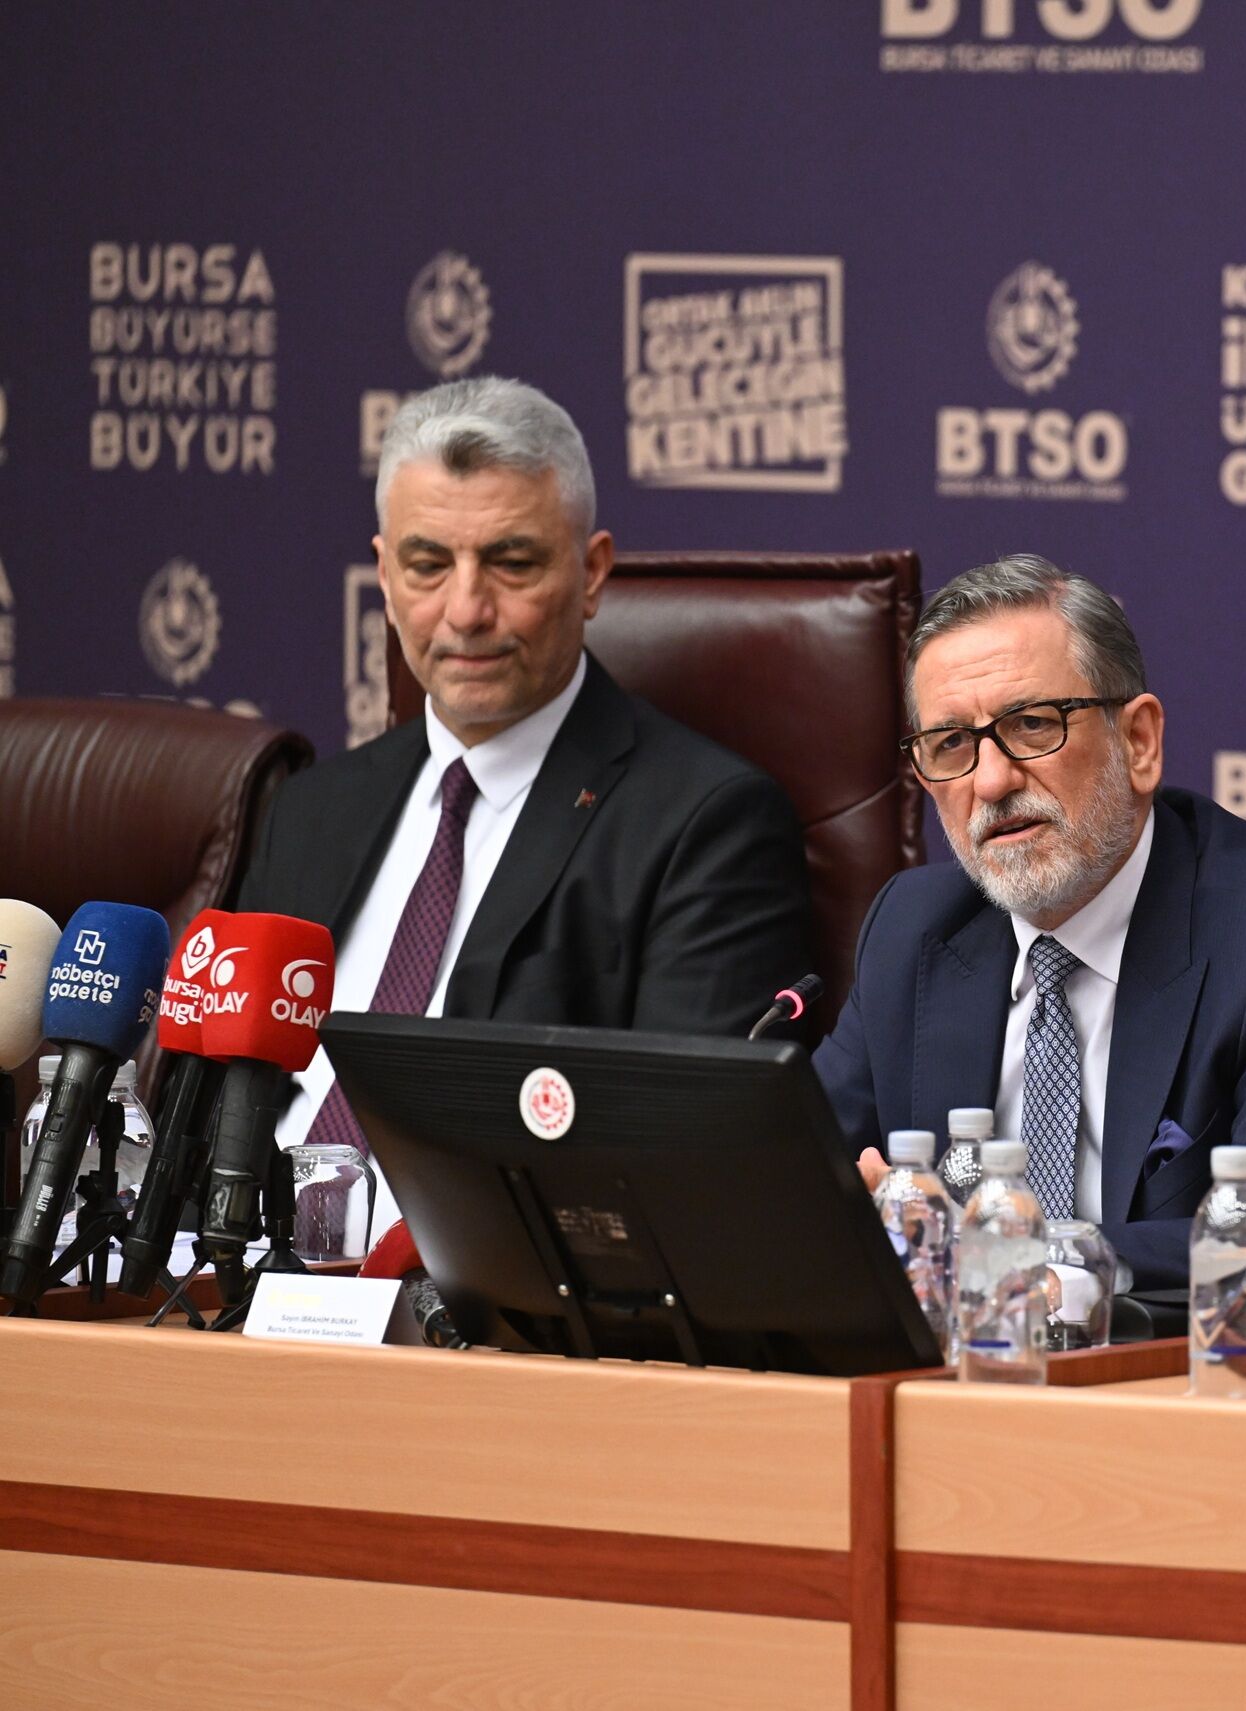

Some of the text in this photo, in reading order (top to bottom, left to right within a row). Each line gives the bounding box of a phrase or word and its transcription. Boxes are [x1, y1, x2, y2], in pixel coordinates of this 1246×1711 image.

[90, 243, 274, 303] BURSA
[937, 408, 1127, 481] BTSO
[49, 982, 113, 1004] gazete
[163, 974, 205, 999] bursa
[159, 995, 203, 1026] bugü
[202, 991, 249, 1015] OLAY
[271, 998, 326, 1029] OLAY
